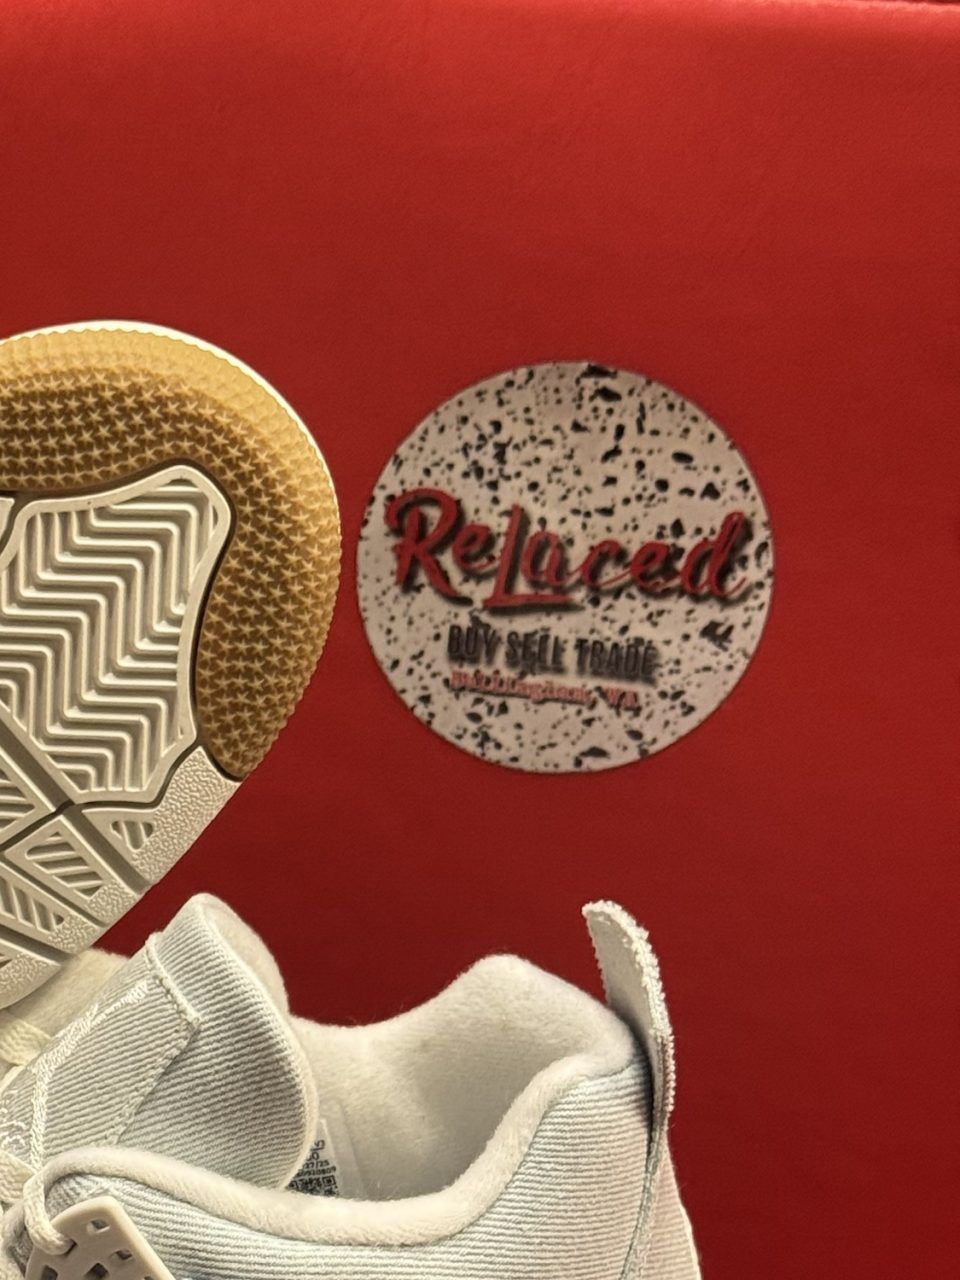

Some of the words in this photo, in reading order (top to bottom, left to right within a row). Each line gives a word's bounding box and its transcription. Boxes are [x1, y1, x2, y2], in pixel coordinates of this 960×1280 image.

[448, 624, 500, 664] BUY
[505, 631, 565, 674] SELL
[575, 637, 659, 684] TRADE
